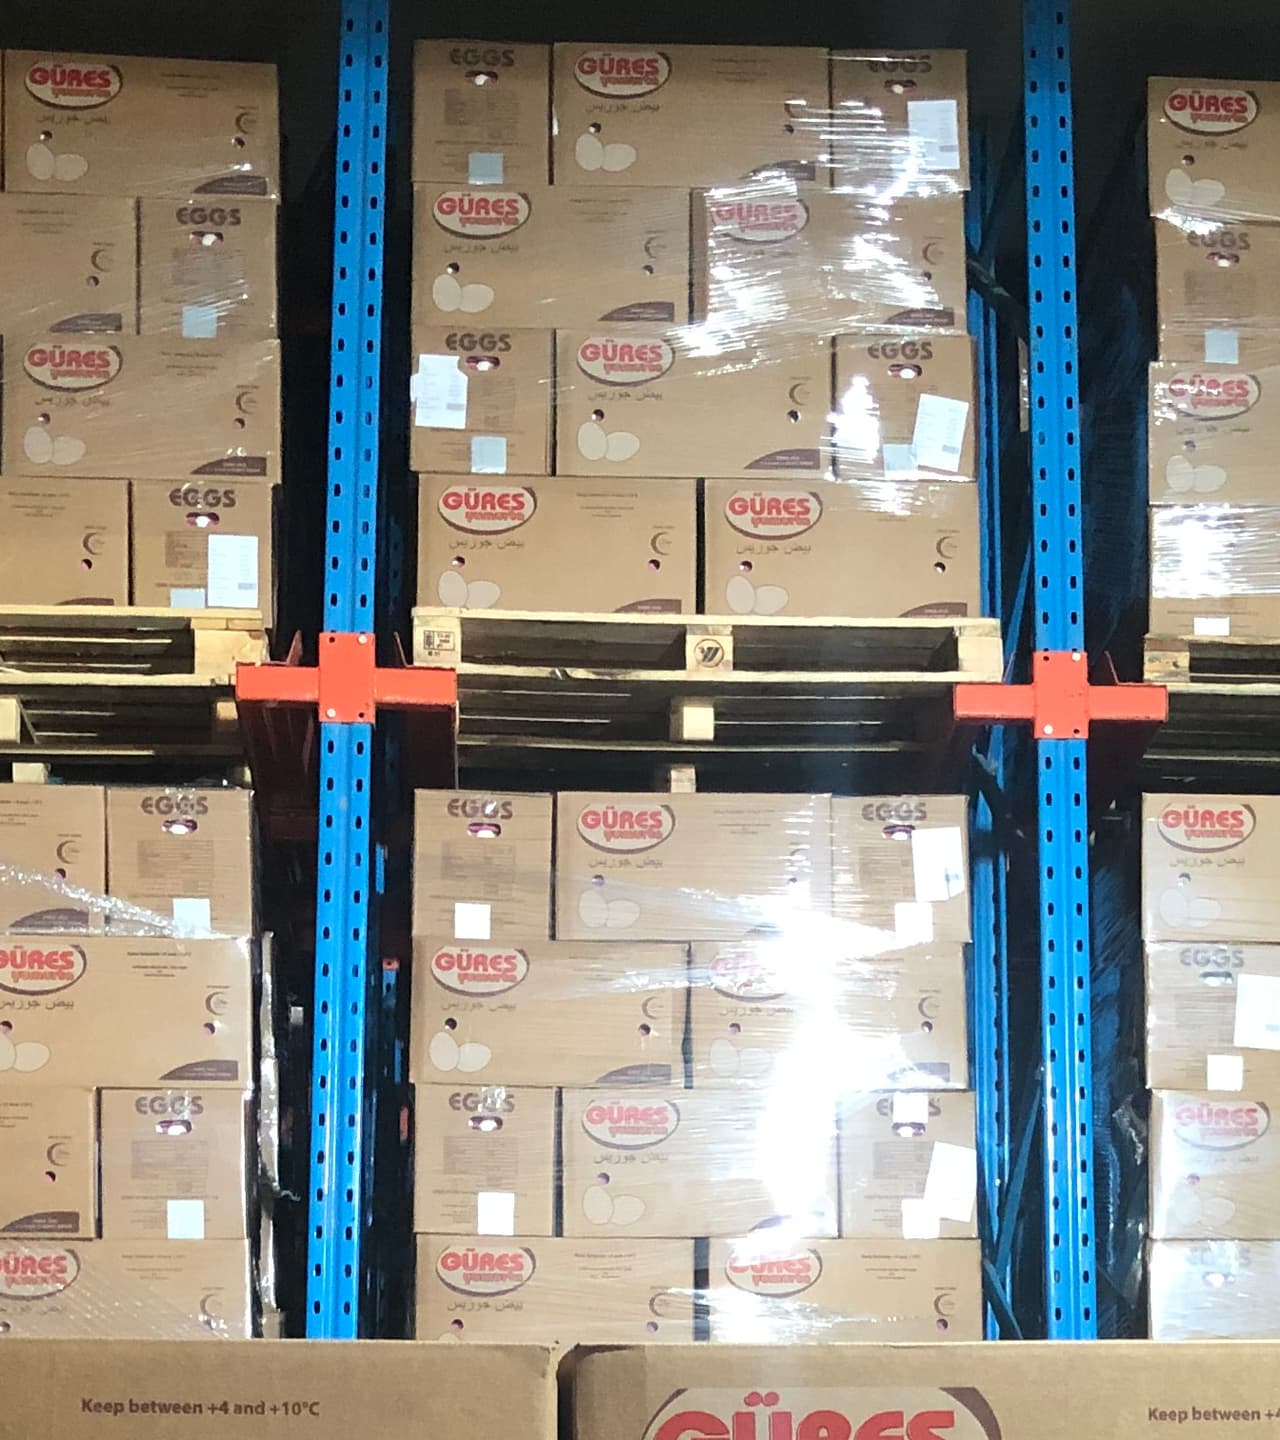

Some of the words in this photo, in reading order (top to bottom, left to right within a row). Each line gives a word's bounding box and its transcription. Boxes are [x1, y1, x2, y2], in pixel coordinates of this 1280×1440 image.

[450, 48, 514, 69] EGGS
[577, 51, 659, 79] GÜRES
[29, 61, 111, 89] GÜRES
[1168, 88, 1249, 115] GÜRES
[176, 206, 241, 226] EGGS
[437, 192, 520, 219] GÜRES
[446, 332, 511, 353] EGGS
[868, 341, 932, 361] EGGS
[443, 487, 526, 516] GÜRES
[729, 490, 811, 520] GÜRES
[582, 805, 664, 830] GÜRES
[1163, 806, 1244, 830] GÜRES
[436, 948, 518, 973] GÜRES
[82, 1398, 124, 1416] Keep
[129, 1399, 203, 1414] between
[208, 1401, 228, 1415] +4
[234, 1402, 265, 1415] and
[270, 1401, 320, 1416] +10°C
[1148, 1407, 1188, 1423] Keep
[1192, 1406, 1260, 1421] between
